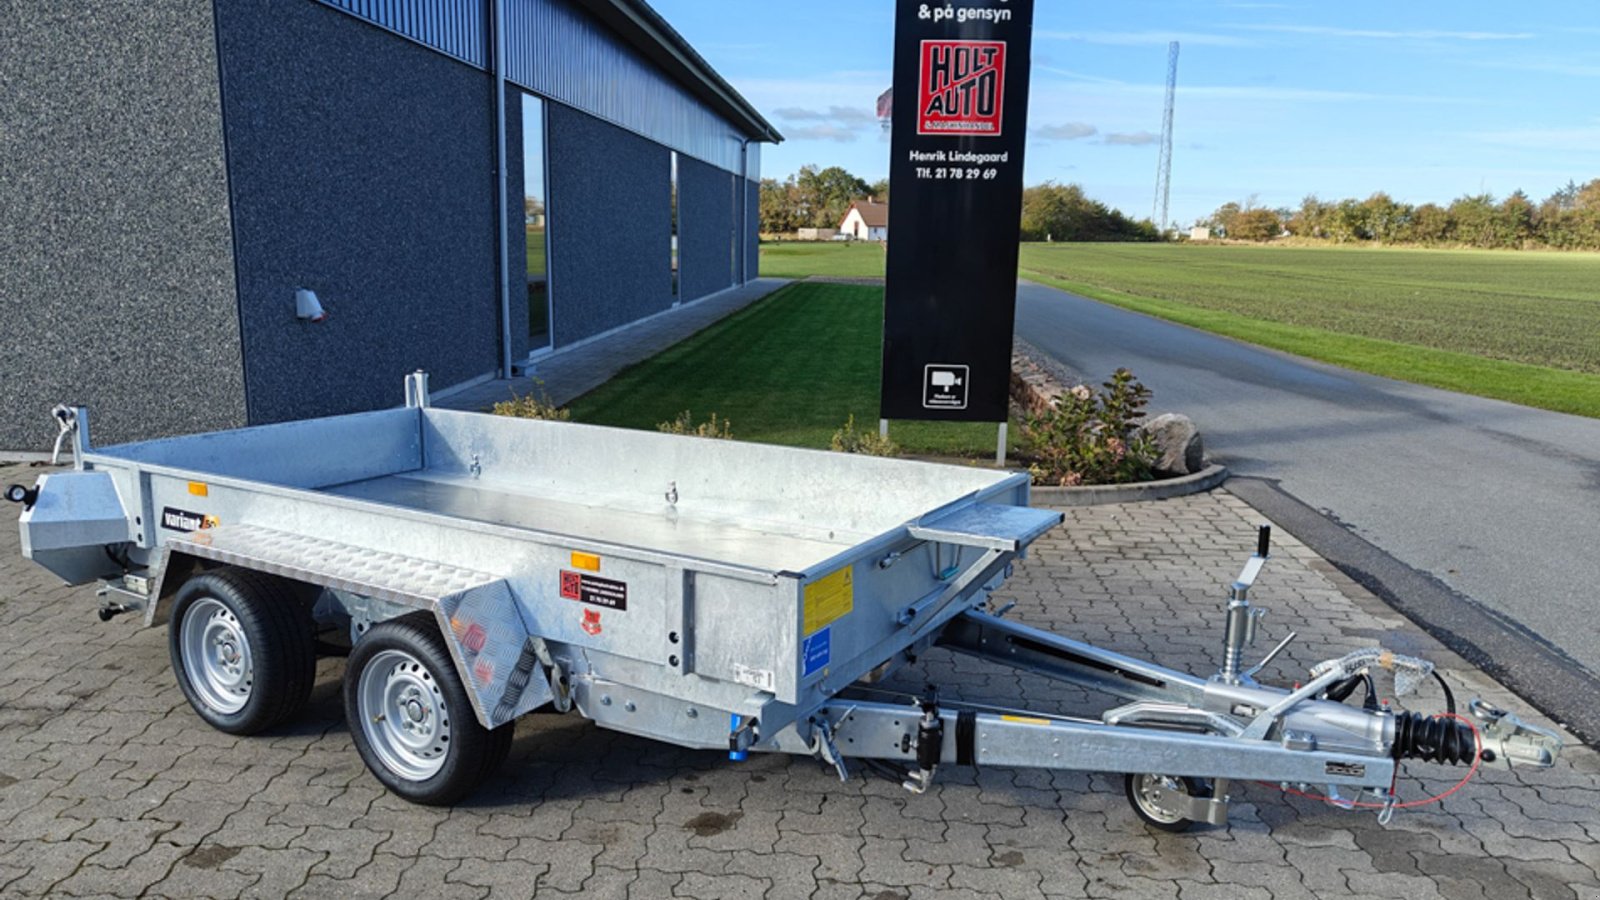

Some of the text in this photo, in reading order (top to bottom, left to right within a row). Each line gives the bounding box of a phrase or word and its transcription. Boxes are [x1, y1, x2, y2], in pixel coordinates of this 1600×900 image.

[918, 3, 1011, 23] & på gensyn
[930, 46, 999, 94] HOLT
[924, 68, 997, 117] AUTO
[909, 150, 1008, 165] Henrik Lindegaard
[916, 167, 997, 179] Tlf. 21 78 29 69
[165, 512, 200, 531] variant
